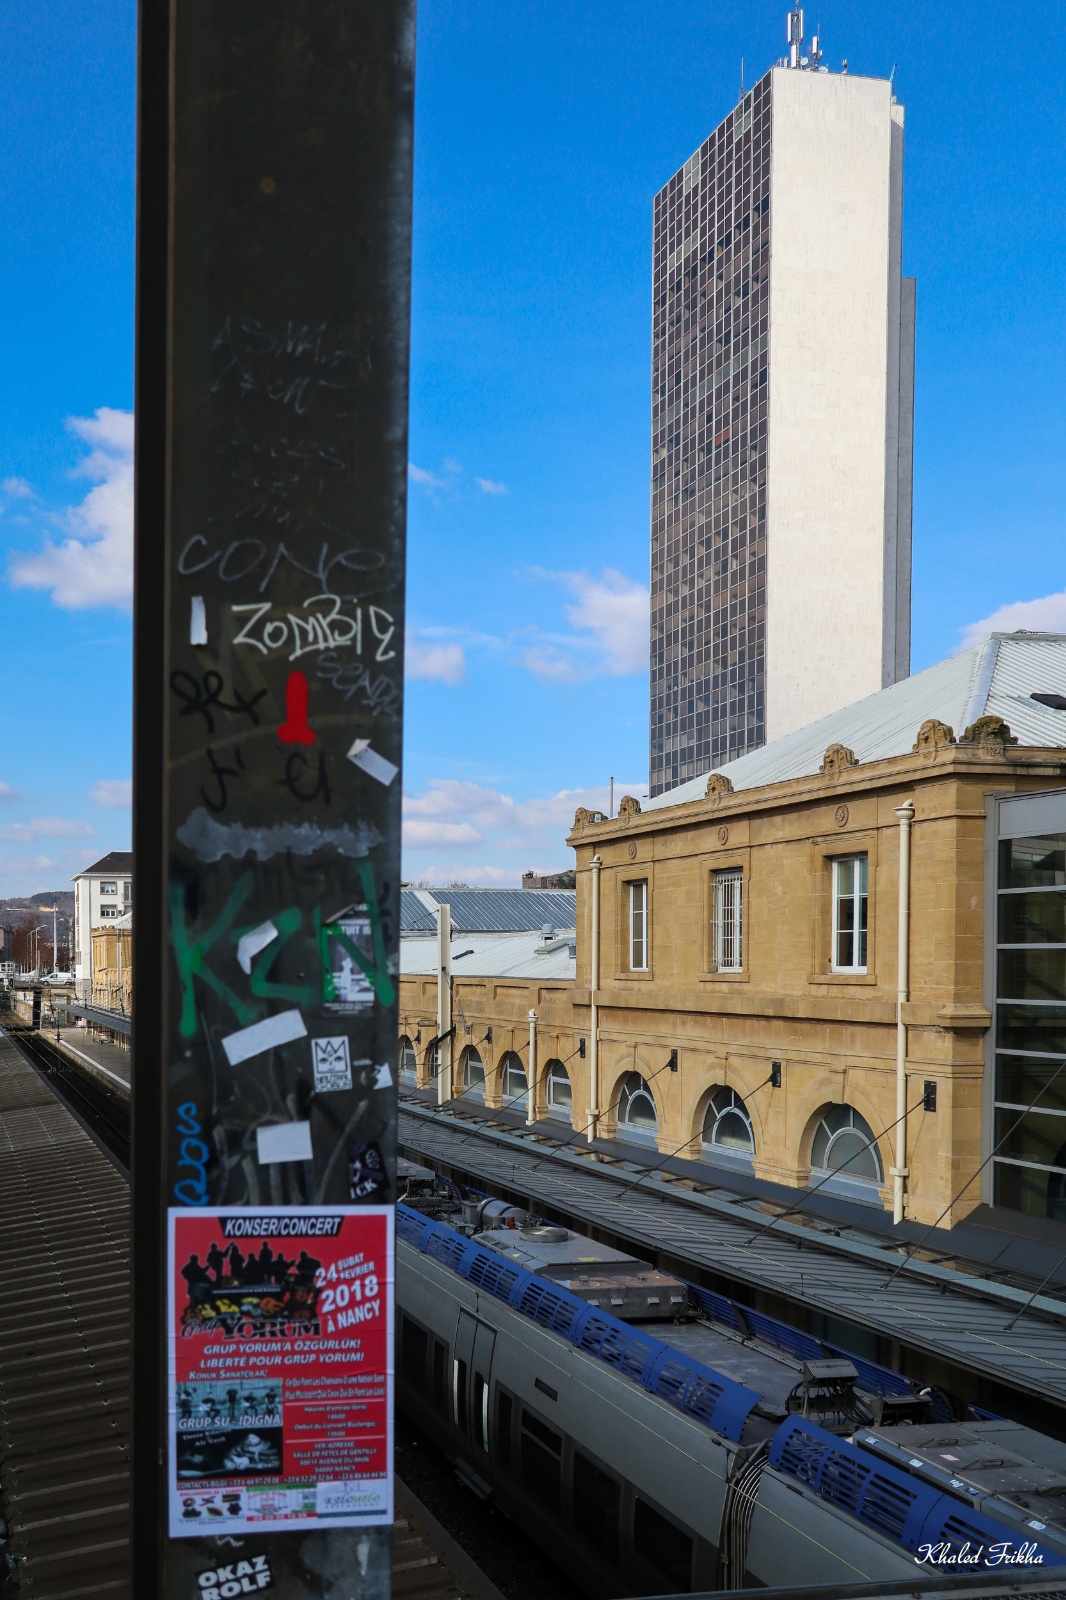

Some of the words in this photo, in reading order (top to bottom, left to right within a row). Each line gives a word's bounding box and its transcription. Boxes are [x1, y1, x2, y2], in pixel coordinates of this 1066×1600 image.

[224, 1217, 341, 1236] KONSER/CONCERT
[315, 1263, 339, 1289] 24
[321, 1275, 379, 1313] 2018
[337, 1299, 381, 1328] NANCY
[220, 1315, 322, 1341] YORUM
[200, 1355, 246, 1369] LIBERTÉ
[248, 1355, 282, 1367] POUR
[284, 1354, 317, 1365] GRUP
[319, 1352, 365, 1364] YORUM!
[204, 1344, 237, 1355] GRUP
[178, 1418, 212, 1429] GRUP
[214, 1416, 230, 1427] SU
[198, 1555, 269, 1587] OKAZ
[201, 1571, 272, 1600] ROLF
